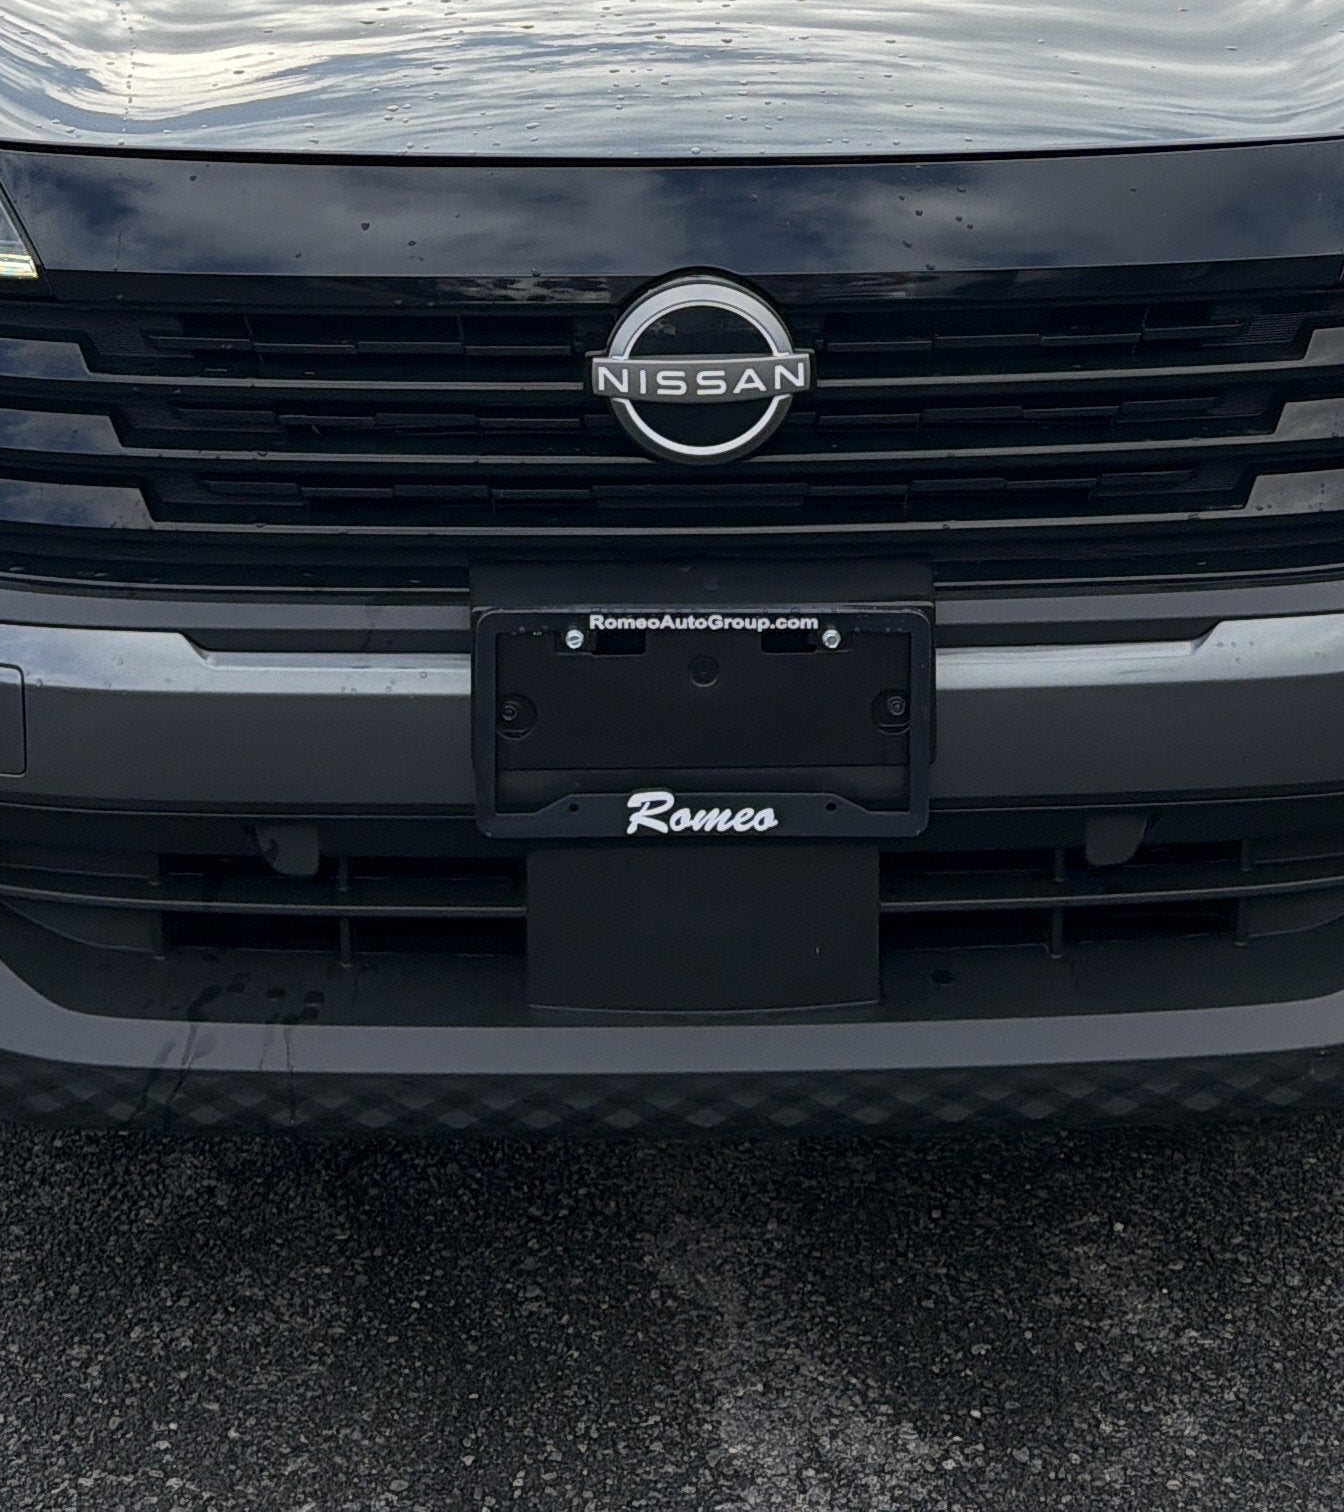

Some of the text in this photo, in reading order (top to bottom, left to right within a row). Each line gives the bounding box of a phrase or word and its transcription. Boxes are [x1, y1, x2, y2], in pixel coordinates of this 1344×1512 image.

[598, 362, 805, 396] NISSAN
[589, 614, 819, 632] RomeoAutoGroup.com
[626, 791, 778, 835] Romeo
